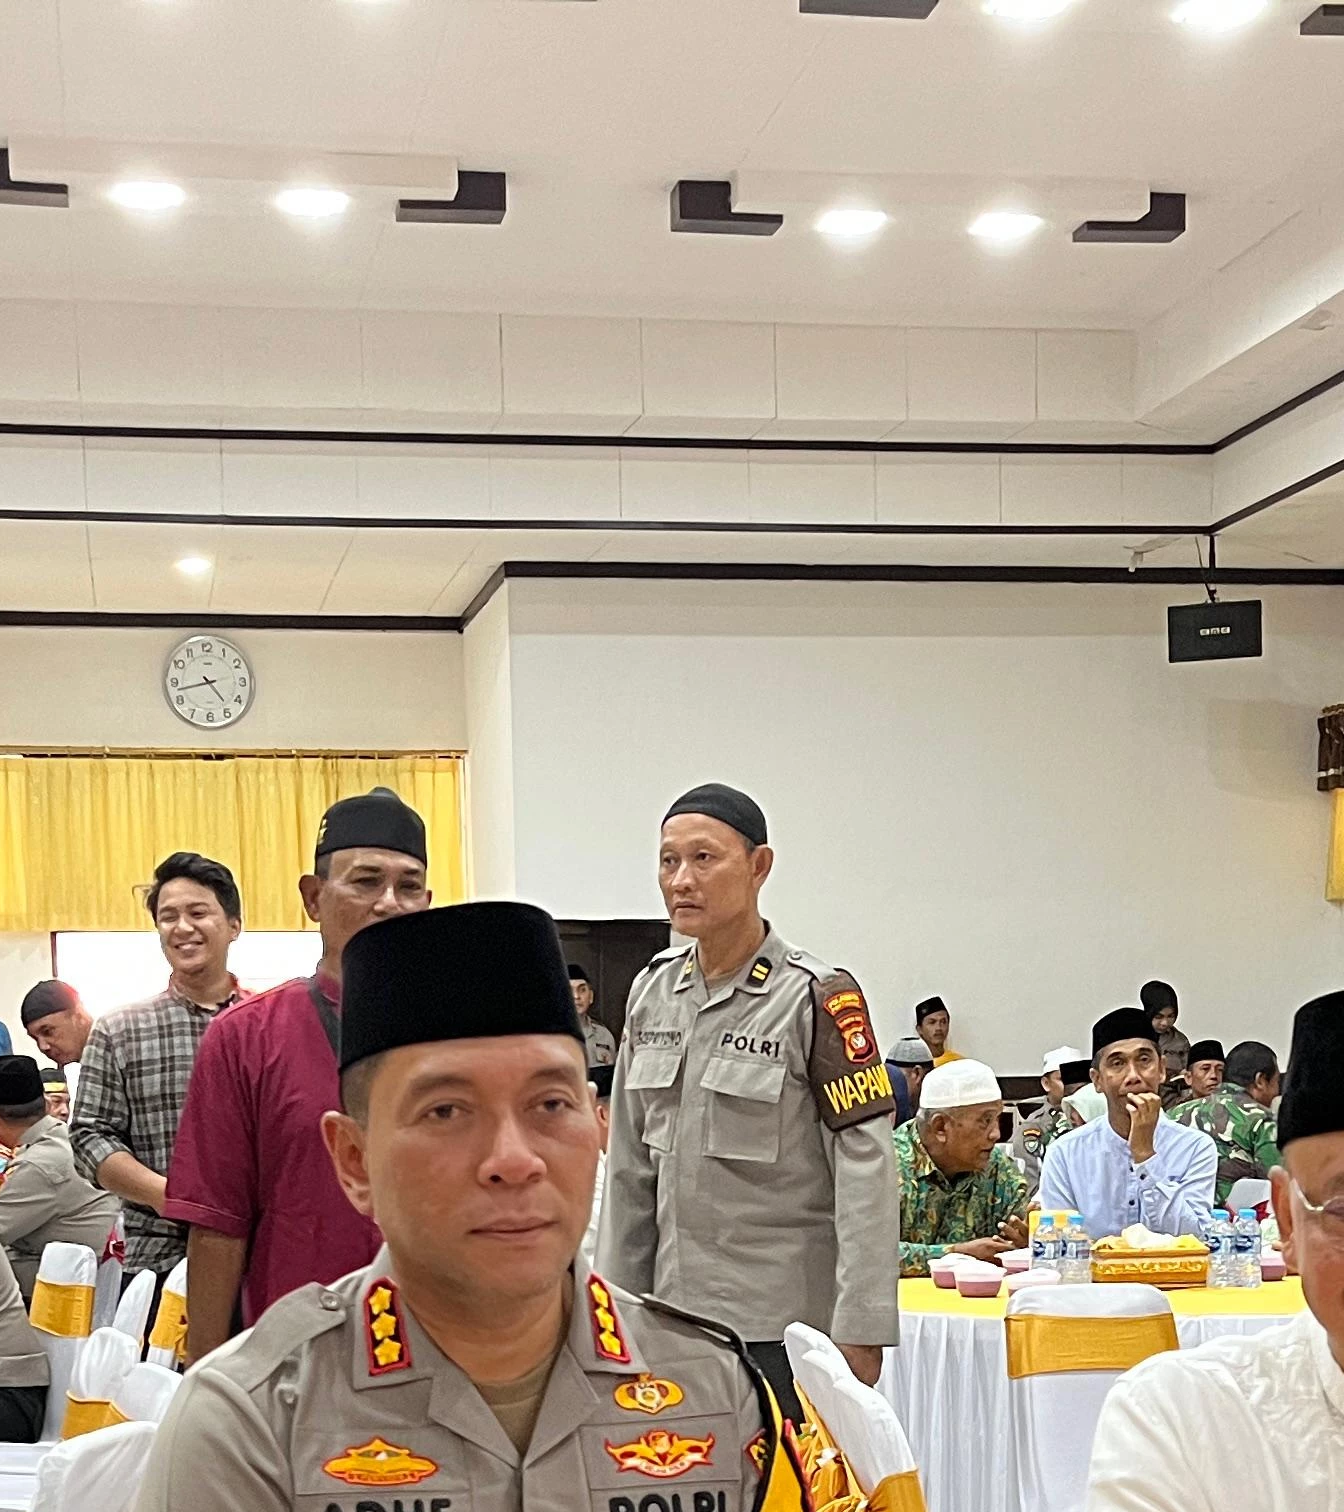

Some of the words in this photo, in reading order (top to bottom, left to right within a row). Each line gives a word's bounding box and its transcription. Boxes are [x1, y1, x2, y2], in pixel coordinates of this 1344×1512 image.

[186, 648, 194, 658] 11
[201, 642, 213, 653] 12
[221, 648, 226, 658] 1
[173, 659, 185, 670] 10
[233, 658, 242, 669] 2
[170, 677, 179, 688] 9
[239, 677, 247, 687] 3
[176, 695, 185, 705] 8
[233, 694, 242, 705] 4
[188, 708, 196, 719] 7
[206, 712, 215, 722] 6
[223, 708, 232, 719] 5
[720, 1032, 780, 1059] POLRI
